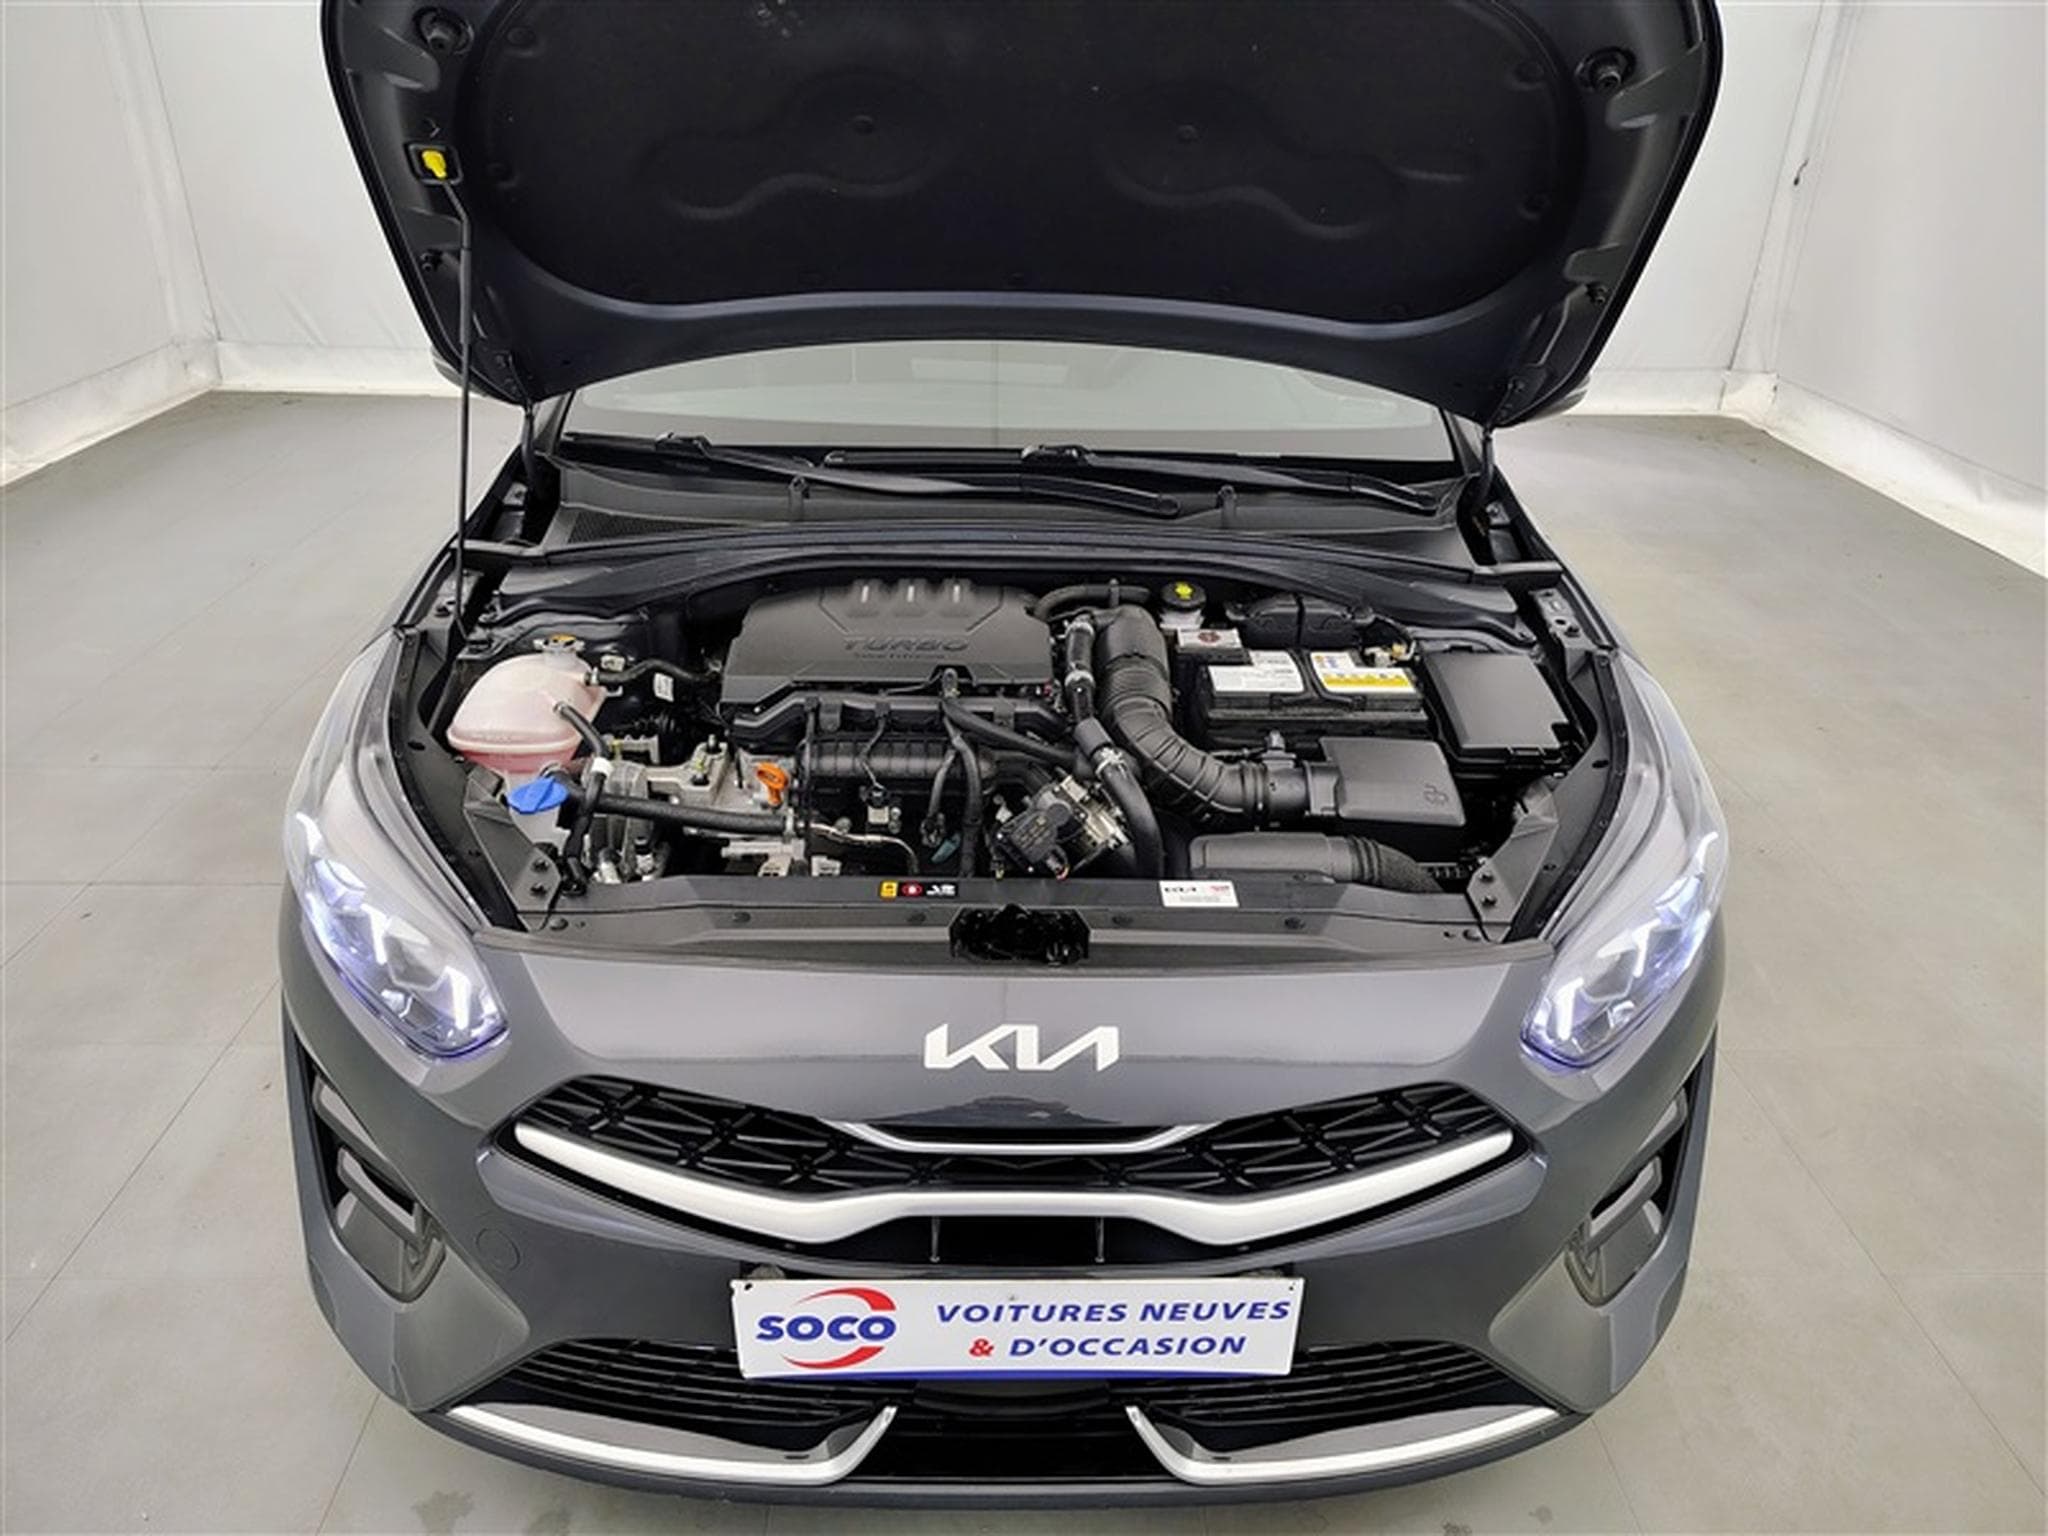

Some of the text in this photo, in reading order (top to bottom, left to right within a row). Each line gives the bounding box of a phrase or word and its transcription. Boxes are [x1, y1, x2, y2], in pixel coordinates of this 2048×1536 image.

[844, 638, 969, 652] TURBO
[937, 1301, 1291, 1323] VOITURES NEUVES
[756, 1315, 896, 1341] SOCO
[968, 1336, 1246, 1357] & D'OCCASION
